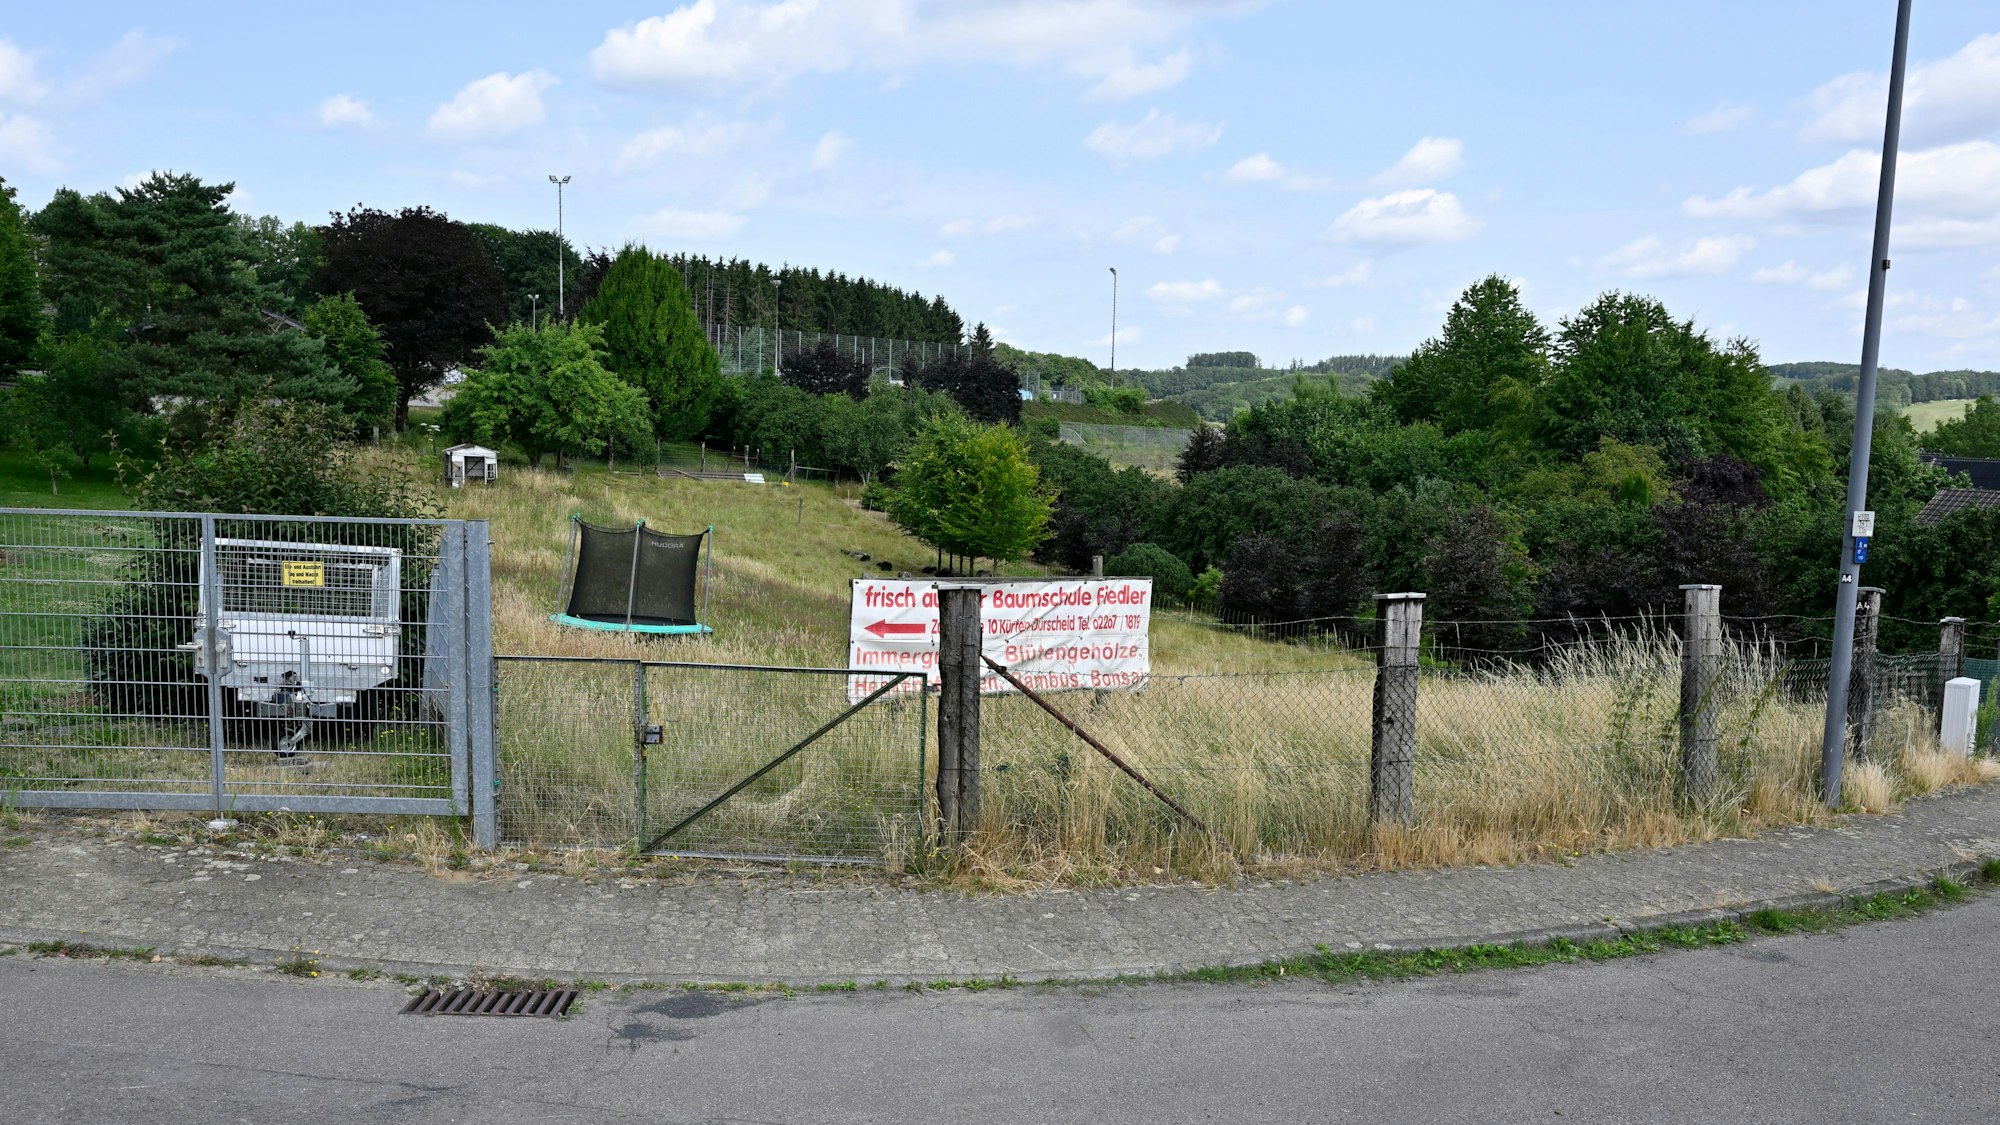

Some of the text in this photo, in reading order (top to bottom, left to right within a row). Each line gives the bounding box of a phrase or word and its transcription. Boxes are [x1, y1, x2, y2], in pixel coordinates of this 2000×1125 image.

[651, 541, 684, 549] HUDORA
[1841, 574, 1852, 583] A4
[865, 585, 916, 608] frisch
[992, 586, 1091, 609] Baumschule
[1096, 585, 1147, 605] Fiedler
[988, 619, 998, 634] 10
[1078, 615, 1090, 631] Tel.
[1091, 669, 1145, 687] Bonsai
